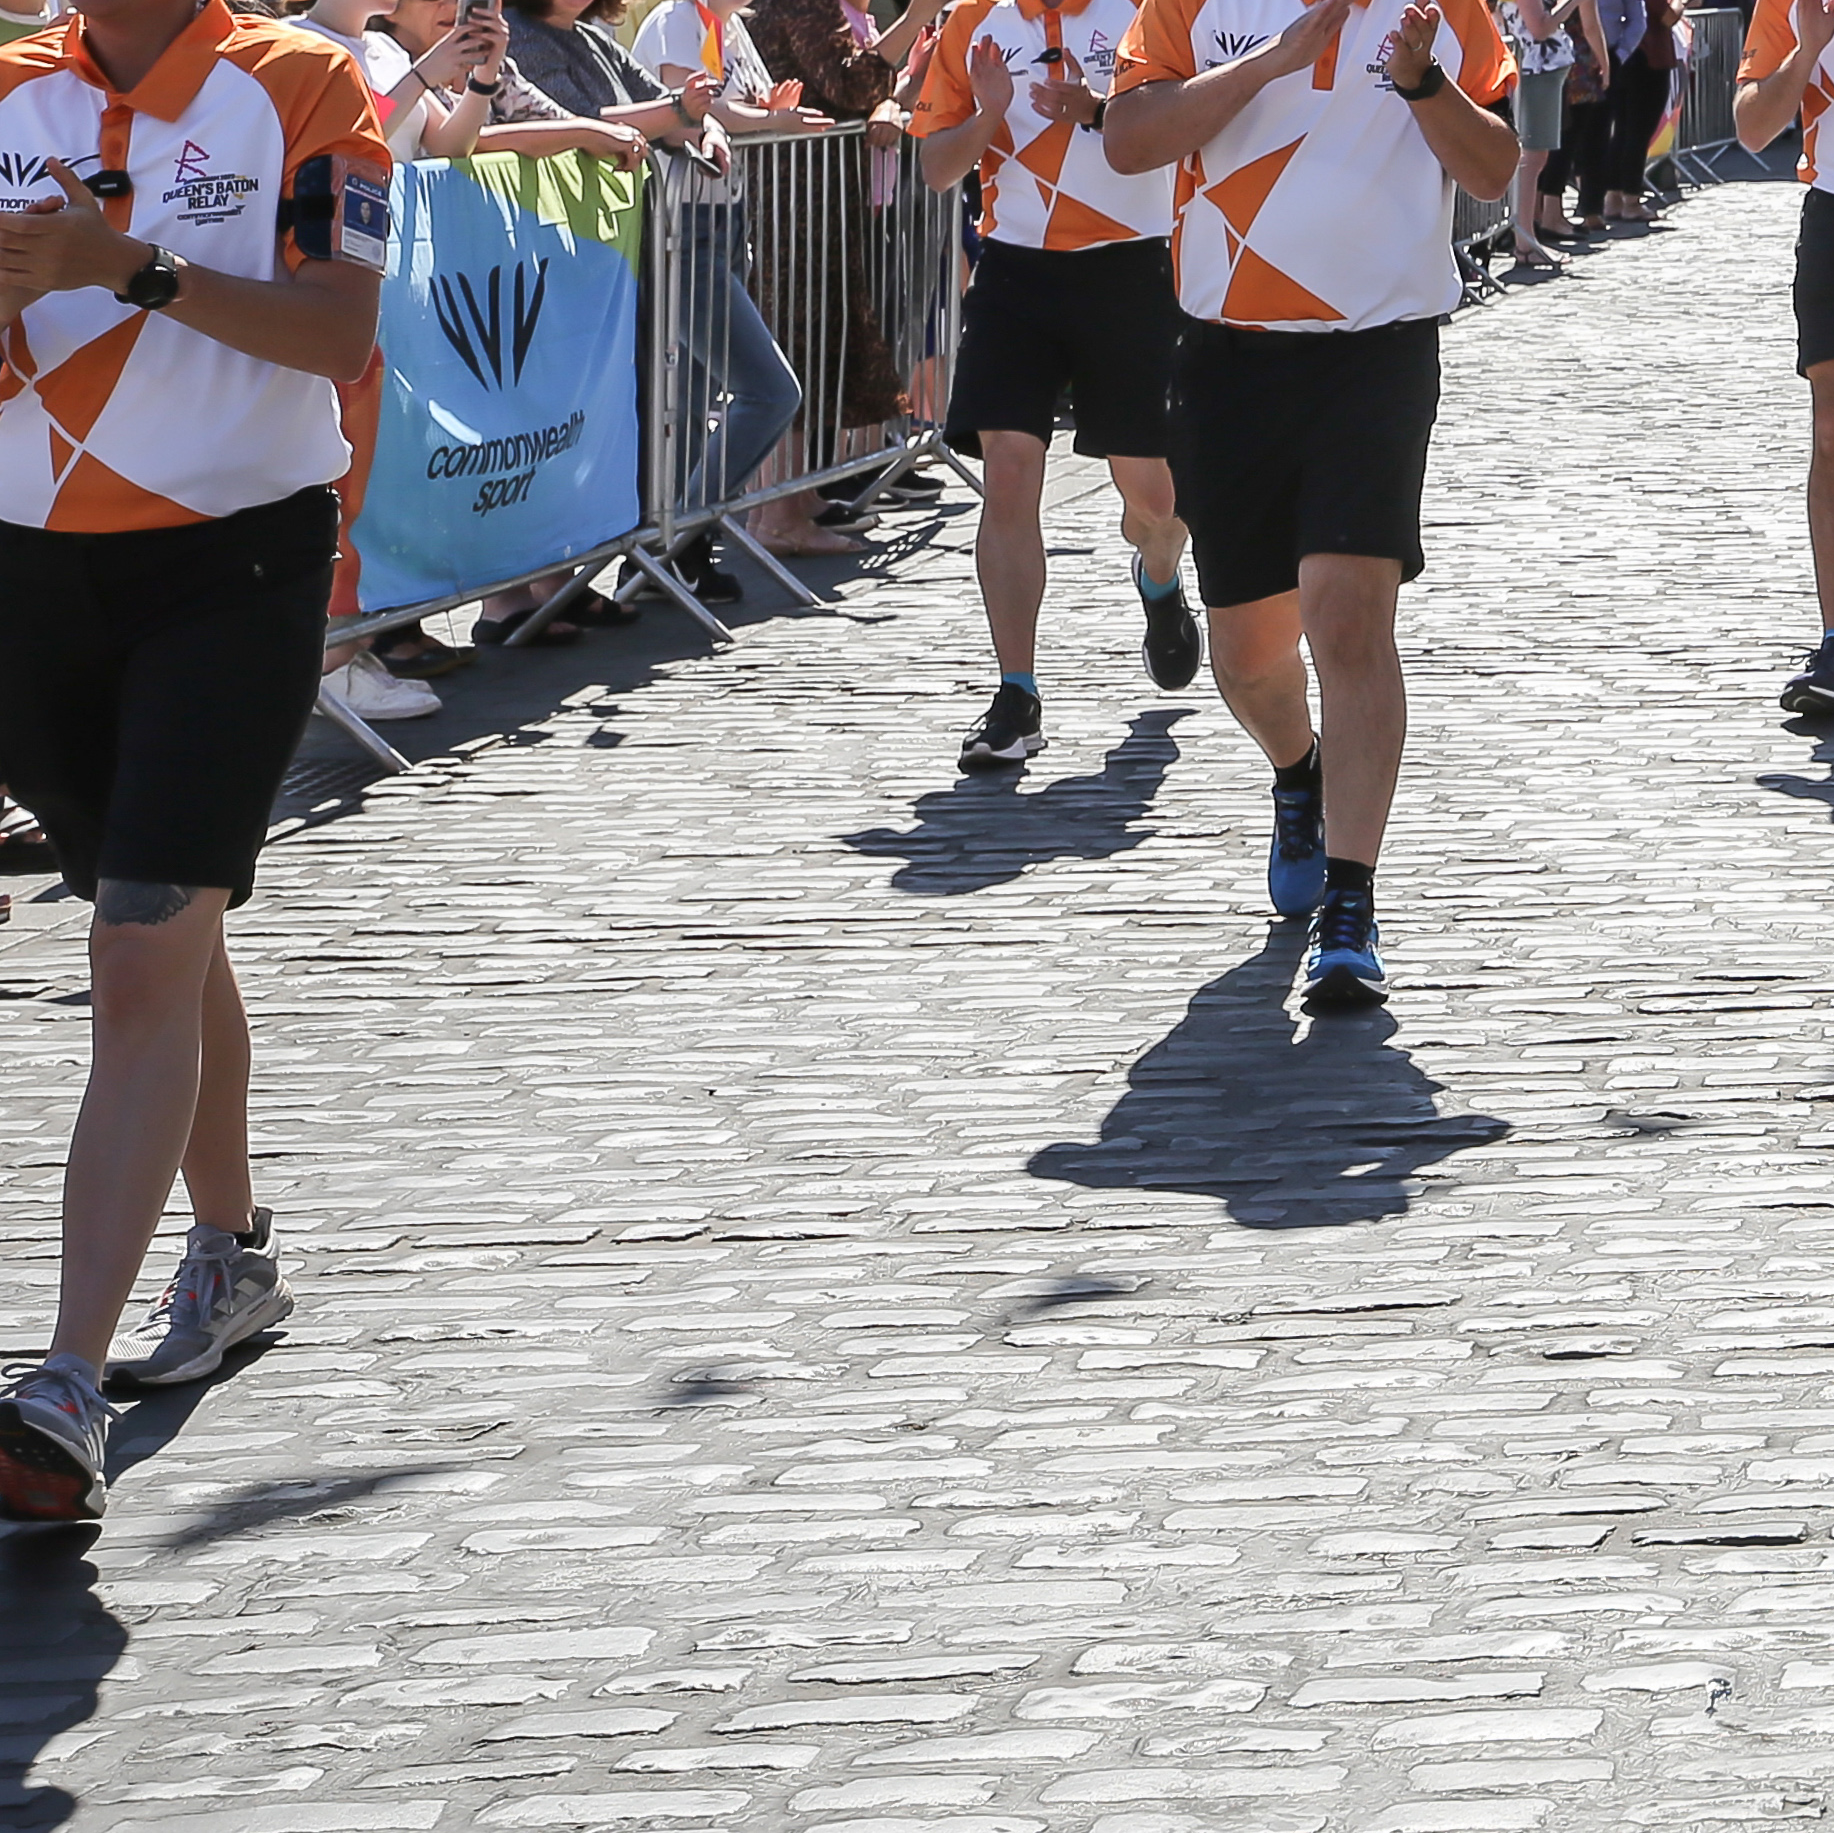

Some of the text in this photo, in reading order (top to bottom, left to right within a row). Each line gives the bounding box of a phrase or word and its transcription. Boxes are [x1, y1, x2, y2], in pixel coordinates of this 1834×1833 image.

[162, 183, 214, 204] QUEEN'S
[216, 178, 259, 195] BATON
[188, 194, 229, 210] RELAY
[427, 409, 585, 480] commonwealth
[472, 469, 536, 517] sport
